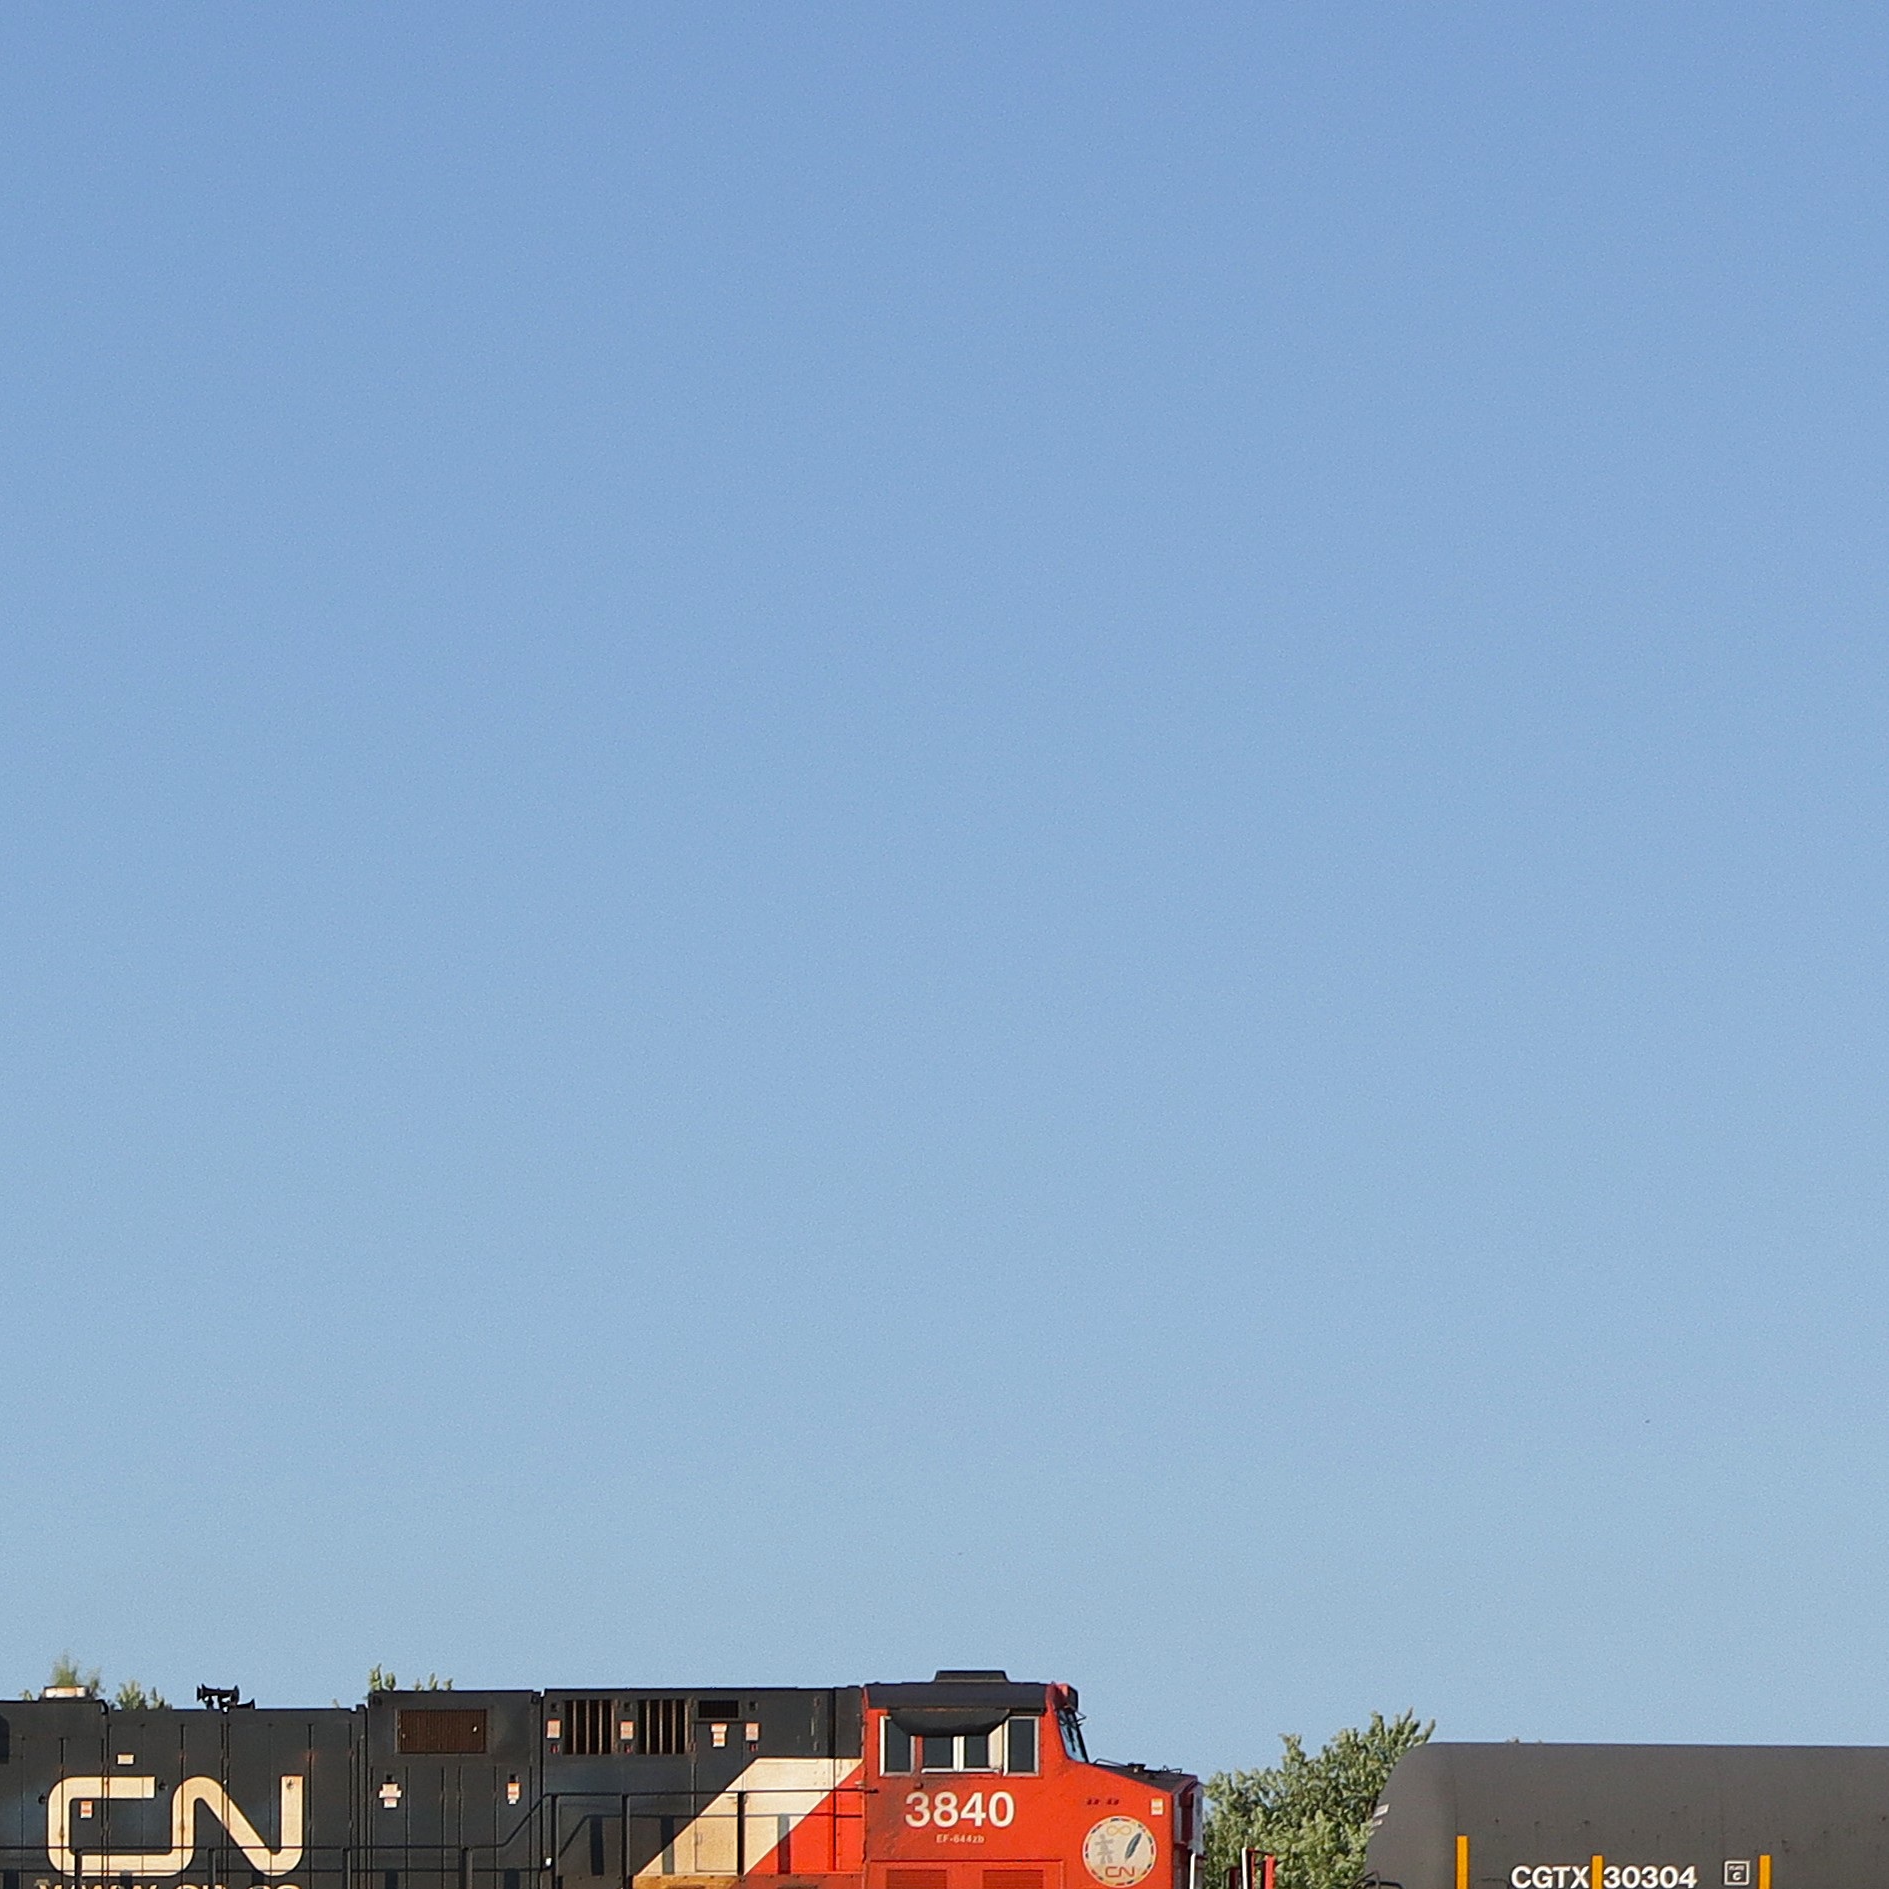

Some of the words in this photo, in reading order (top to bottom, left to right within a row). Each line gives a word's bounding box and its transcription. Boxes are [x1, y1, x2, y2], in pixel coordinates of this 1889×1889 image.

[905, 1791, 1014, 1827] 3840
[48, 1775, 303, 1876] CN
[1105, 1866, 1135, 1878] CN
[1511, 1865, 1589, 1889] CGTX
[1603, 1865, 1697, 1889] 30304
